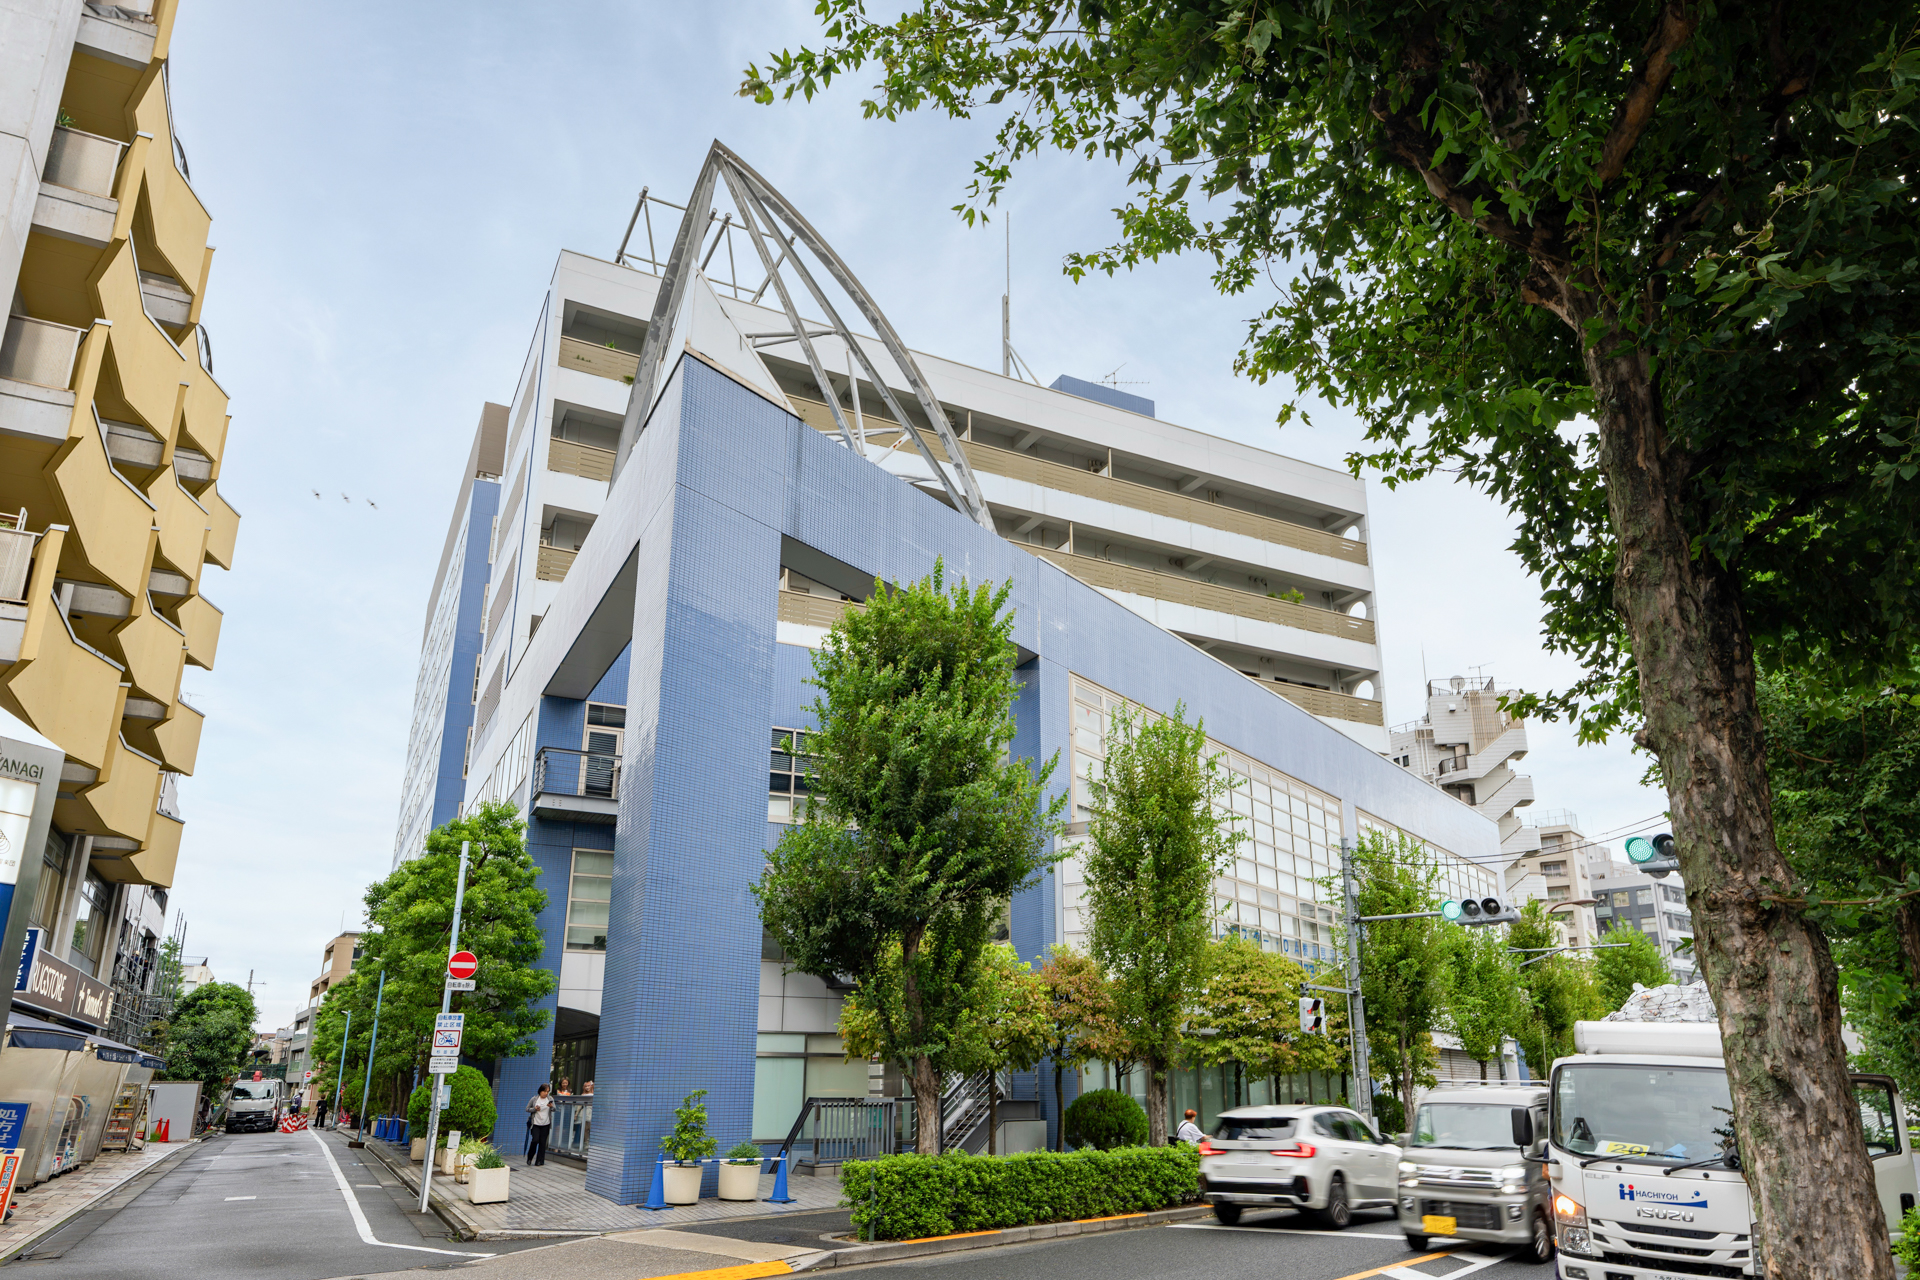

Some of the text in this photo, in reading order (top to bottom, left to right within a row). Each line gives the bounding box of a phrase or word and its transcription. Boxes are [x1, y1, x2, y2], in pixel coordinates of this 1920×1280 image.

[0, 757, 44, 779] ANAGI
[1636, 1190, 1678, 1201] HACHIYOH
[1636, 1206, 1694, 1222] ISUZU
